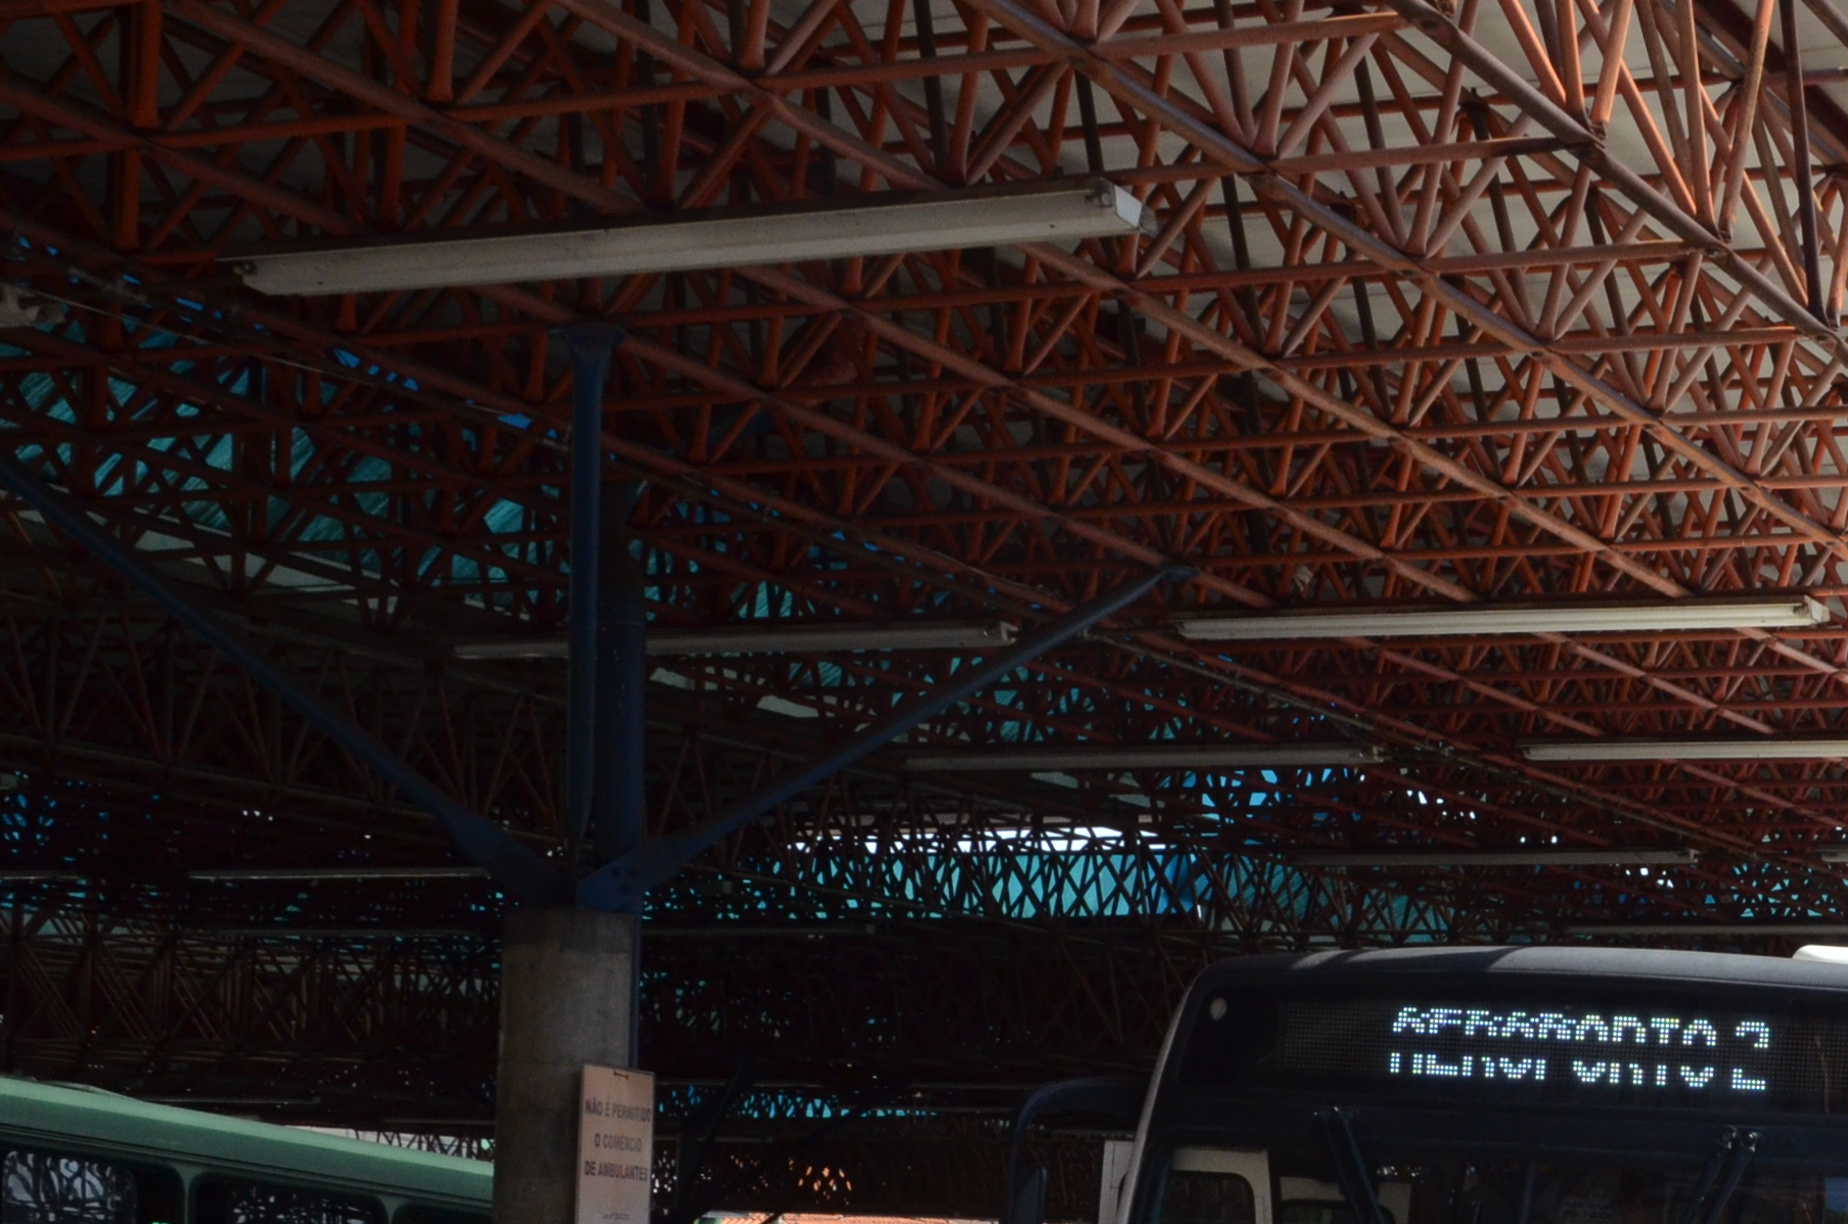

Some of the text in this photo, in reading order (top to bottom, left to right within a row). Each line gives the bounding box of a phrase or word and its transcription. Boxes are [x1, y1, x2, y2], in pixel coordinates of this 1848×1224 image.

[585, 1096, 651, 1122] NÃO É PERMITIDO
[594, 1133, 642, 1152] O COMÉRCIO
[584, 1161, 648, 1182] DE AMBULANTES
